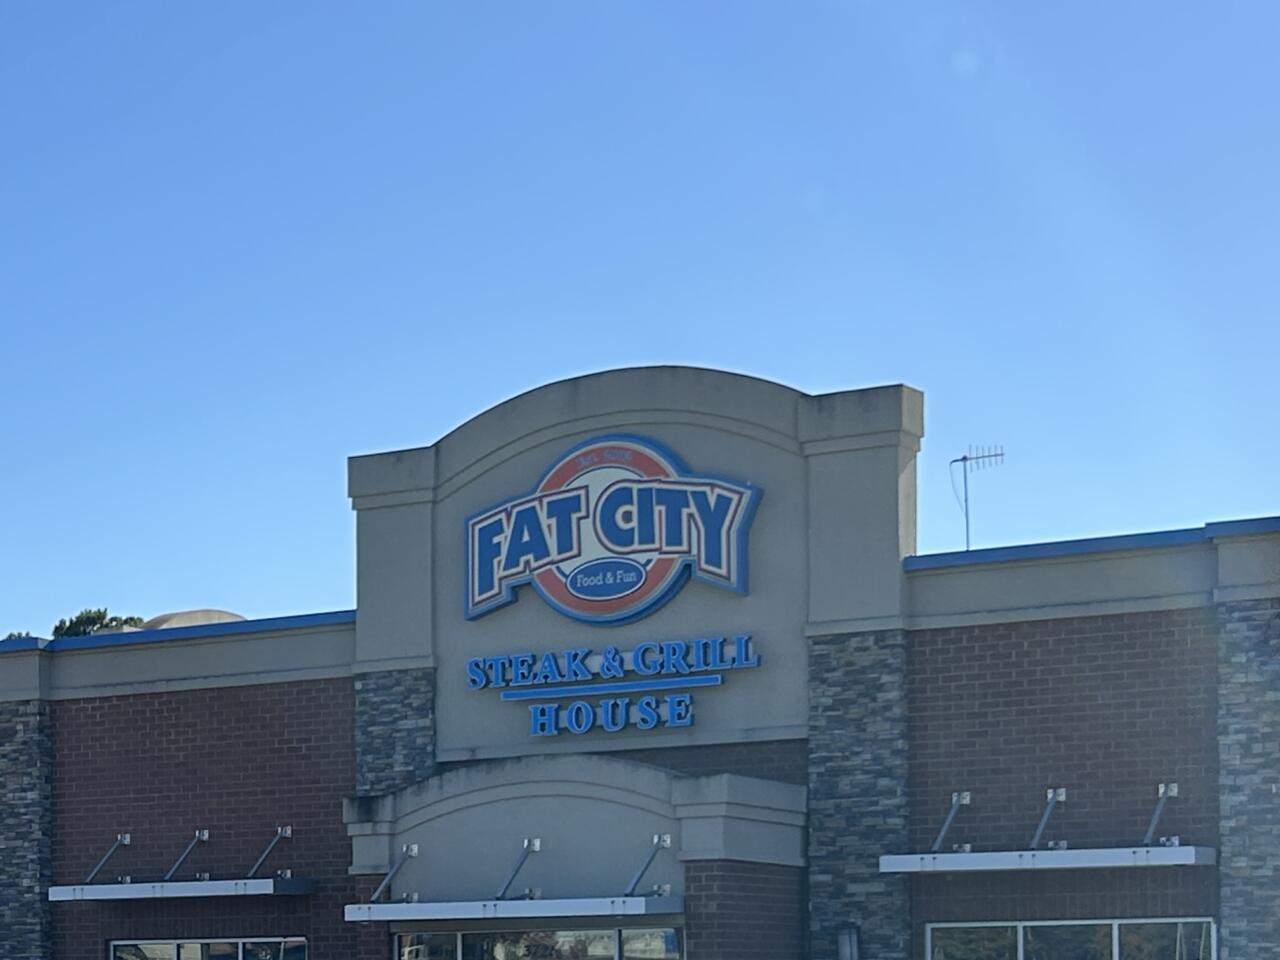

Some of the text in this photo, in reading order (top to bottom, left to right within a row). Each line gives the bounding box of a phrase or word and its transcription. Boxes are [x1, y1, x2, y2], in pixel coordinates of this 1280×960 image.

[474, 480, 744, 602] FAT CITY
[576, 570, 638, 588] Food & Fun
[466, 634, 761, 690] STEAK & GRILL
[528, 694, 695, 737] HOUSE
